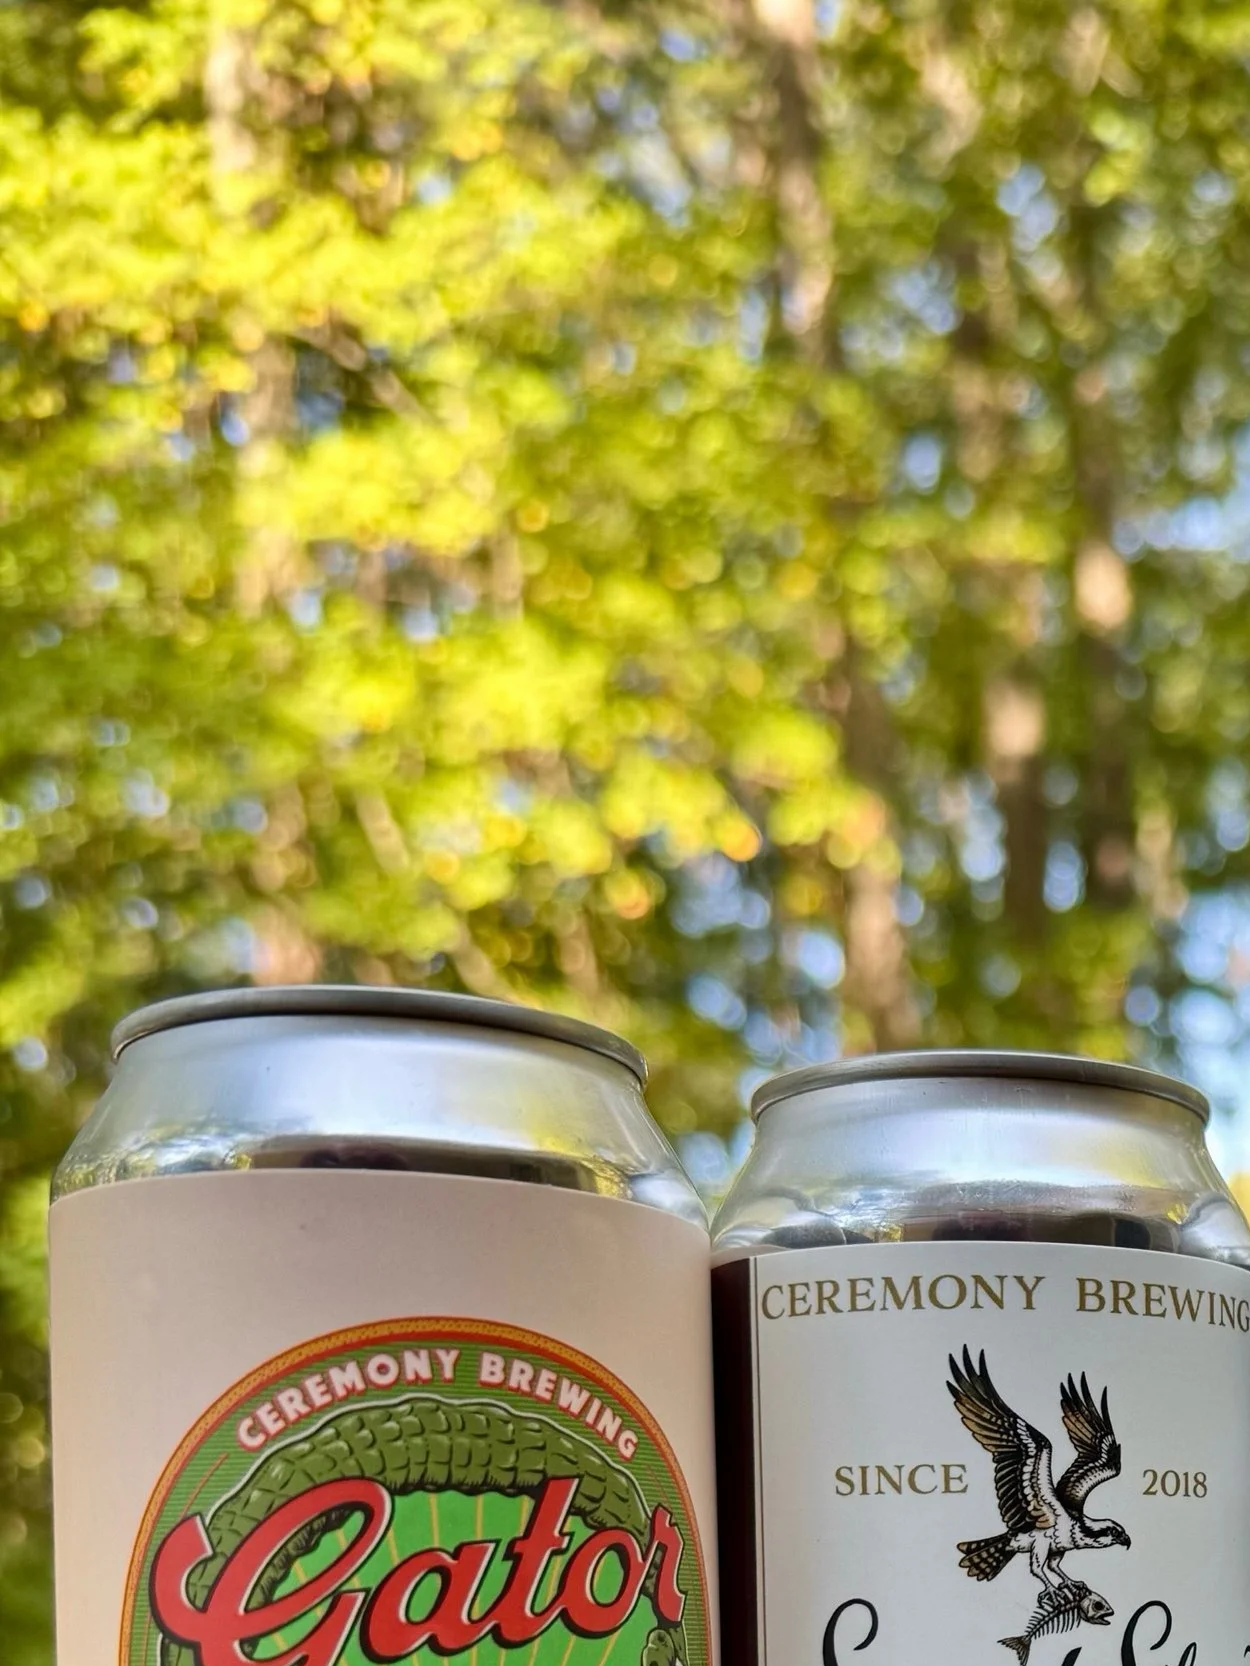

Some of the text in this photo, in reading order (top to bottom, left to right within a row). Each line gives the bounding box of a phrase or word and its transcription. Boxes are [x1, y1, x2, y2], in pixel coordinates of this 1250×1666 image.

[761, 1273, 1250, 1333] CEREMONY BREWING
[236, 1347, 638, 1461] CEREMONY BREWING
[834, 1463, 1208, 1498] SINCE 2018
